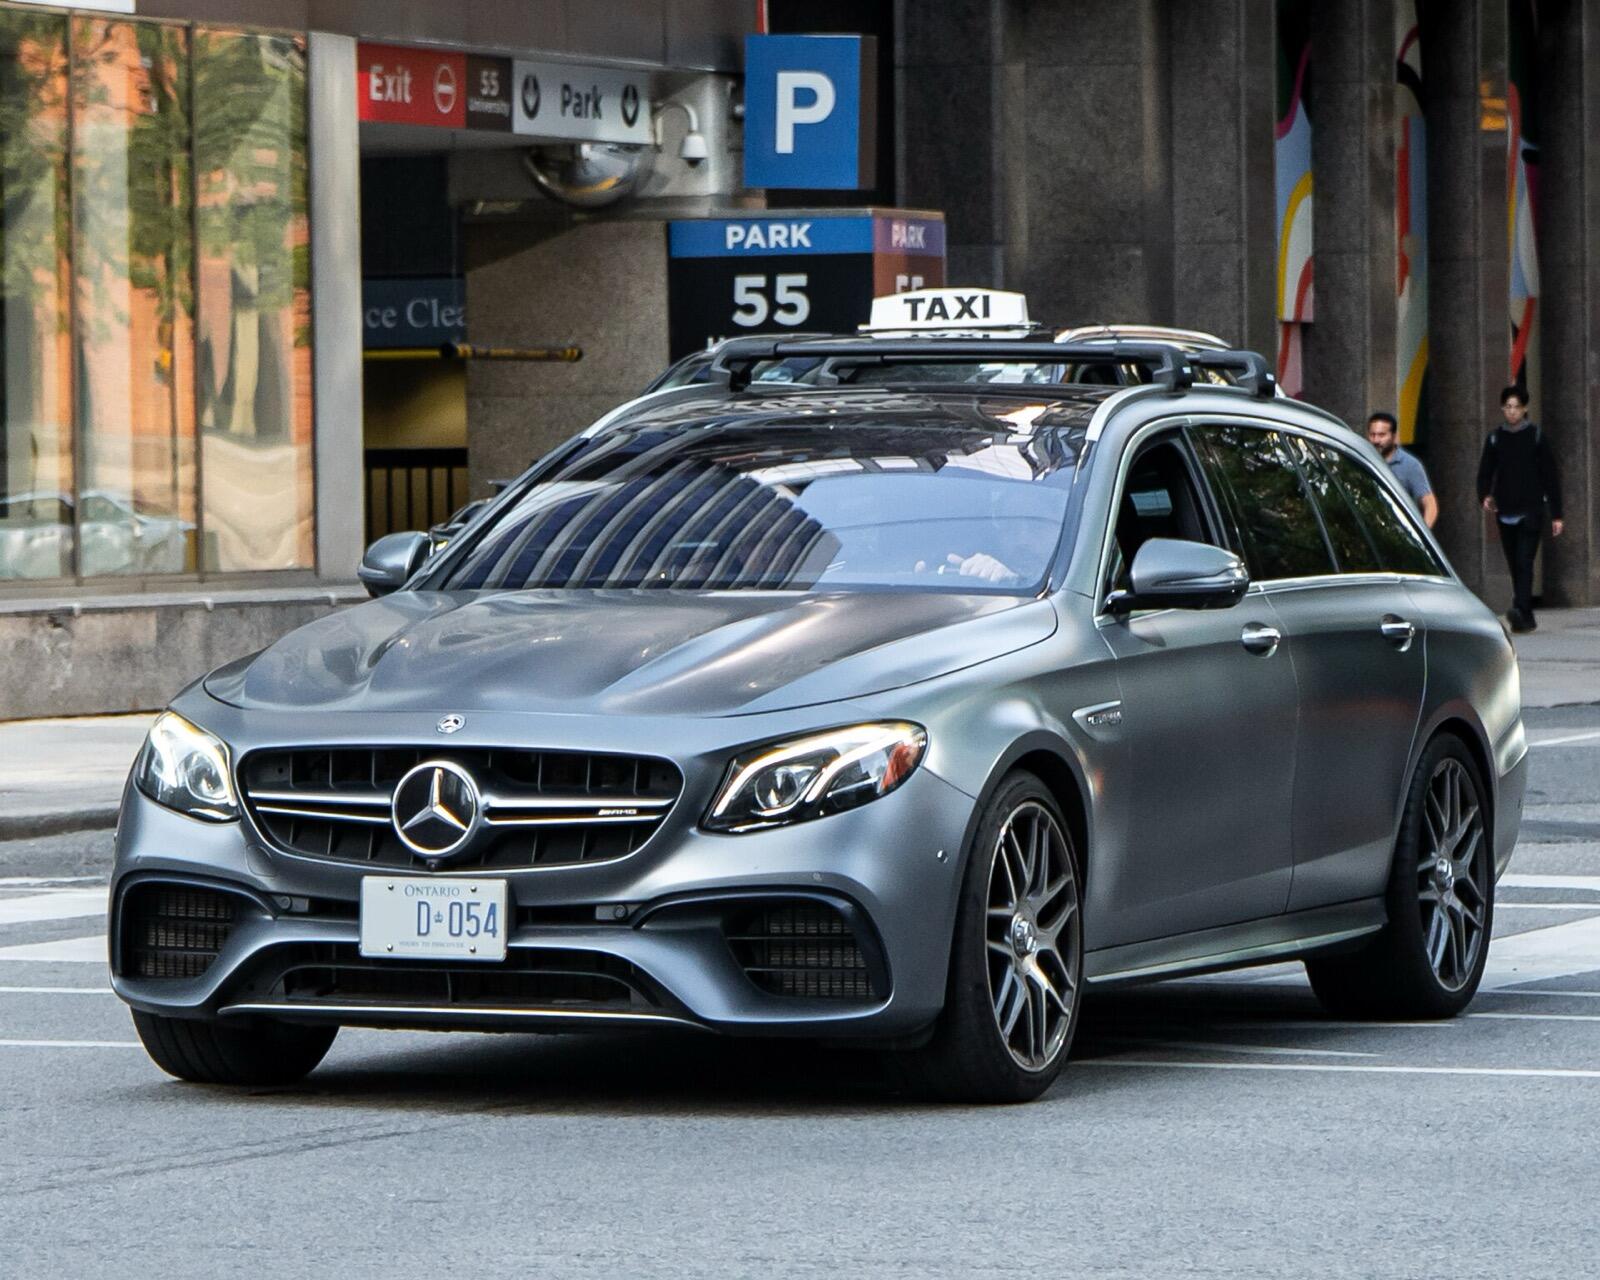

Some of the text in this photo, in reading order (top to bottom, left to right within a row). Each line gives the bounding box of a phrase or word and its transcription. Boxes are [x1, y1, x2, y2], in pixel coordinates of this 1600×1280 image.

[369, 65, 412, 104] Exit
[480, 70, 499, 97] 55
[560, 83, 602, 120] Park
[775, 71, 836, 154] P
[726, 223, 812, 249] PARK
[891, 223, 926, 249] PARK
[732, 274, 811, 327] 55
[903, 295, 990, 321] TAXI
